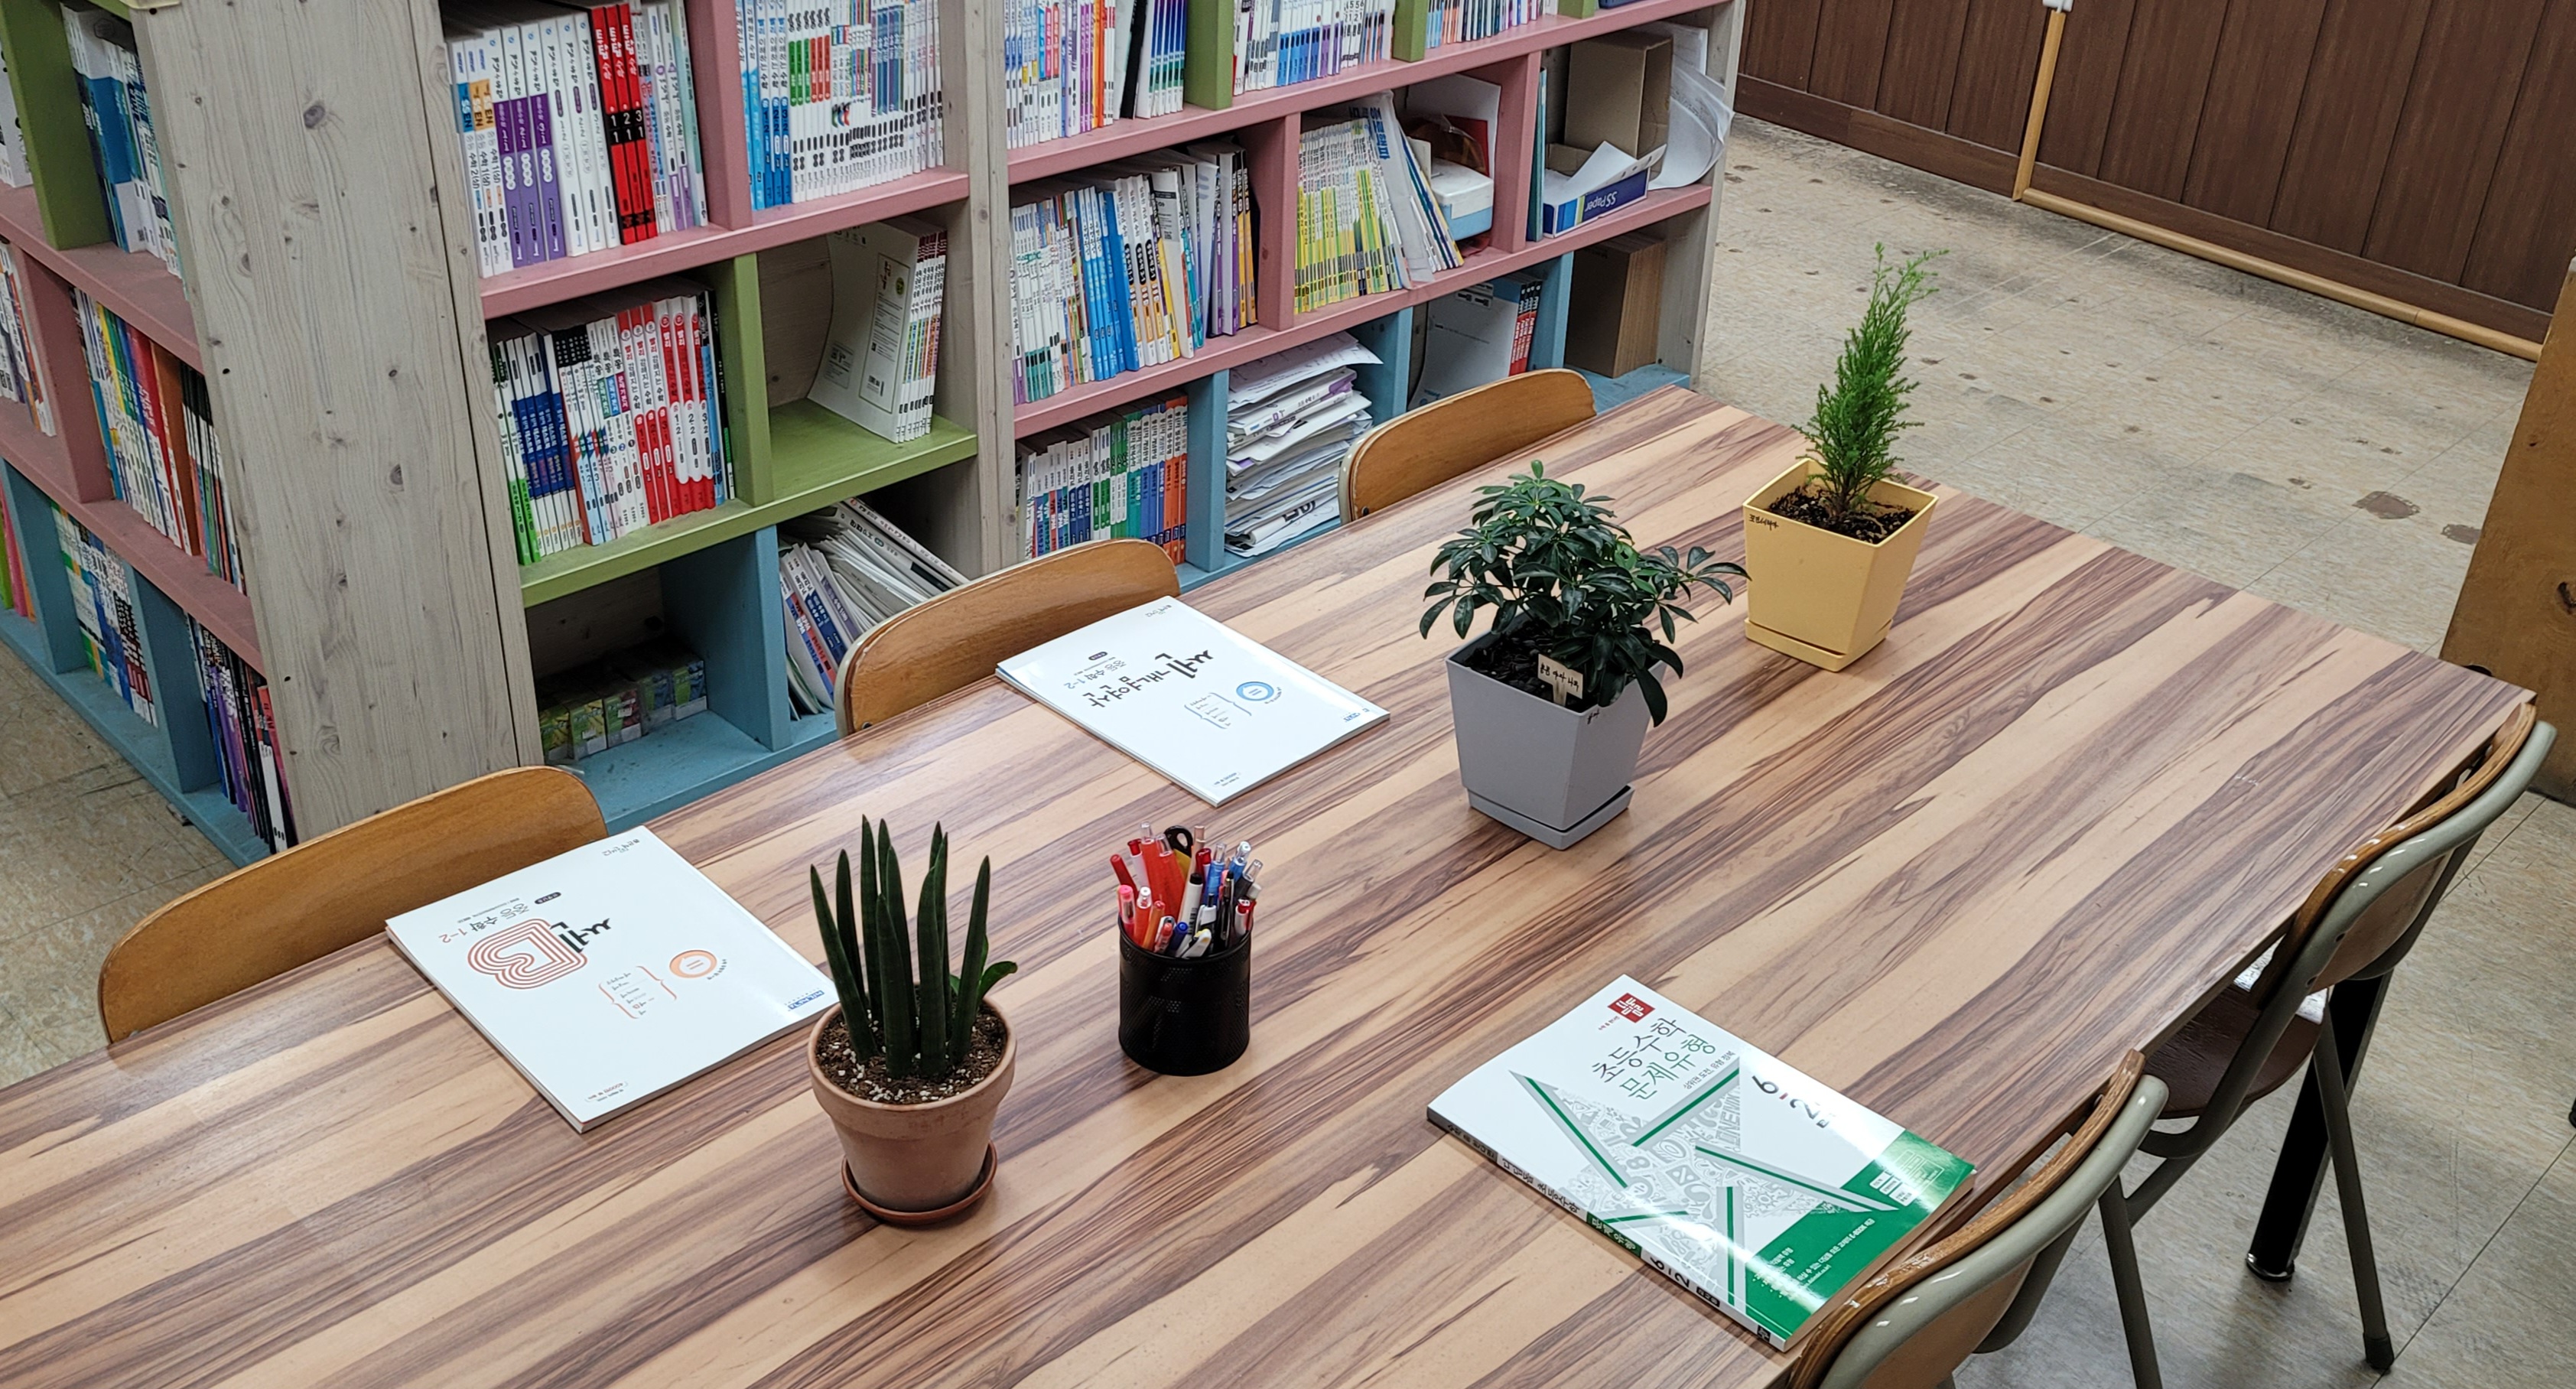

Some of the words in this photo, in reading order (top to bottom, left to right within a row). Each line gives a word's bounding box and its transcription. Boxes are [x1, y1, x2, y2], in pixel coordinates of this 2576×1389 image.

[649, 337, 656, 353] 빨리
[663, 331, 671, 348] 빨리
[677, 330, 685, 346] 빨리
[624, 344, 633, 361] 빨리
[636, 340, 645, 356] 빨리
[626, 363, 638, 393] 강해지는
[639, 358, 649, 389] 강해지는
[651, 354, 662, 385] 강해지는
[632, 394, 640, 410] 수학
[643, 390, 652, 405] 수학
[655, 386, 664, 402] 수학
[1155, 650, 1214, 679] 쎈
[1063, 678, 1085, 689] 1-2
[1083, 668, 1106, 682] 수학
[1083, 669, 1172, 708] 개념연산
[469, 915, 499, 932] 수학
[439, 926, 467, 944] 1-2
[1591, 1017, 1687, 1085] 초등수학
[1619, 1033, 1717, 1102] 문제유형
[1681, 1075, 1703, 1090] 상위권
[1709, 1058, 1725, 1069] 유형
[1719, 1049, 1736, 1062] 정복
[1537, 1179, 1579, 1215] 초등수학
[1591, 1216, 1635, 1253] 문제유형
